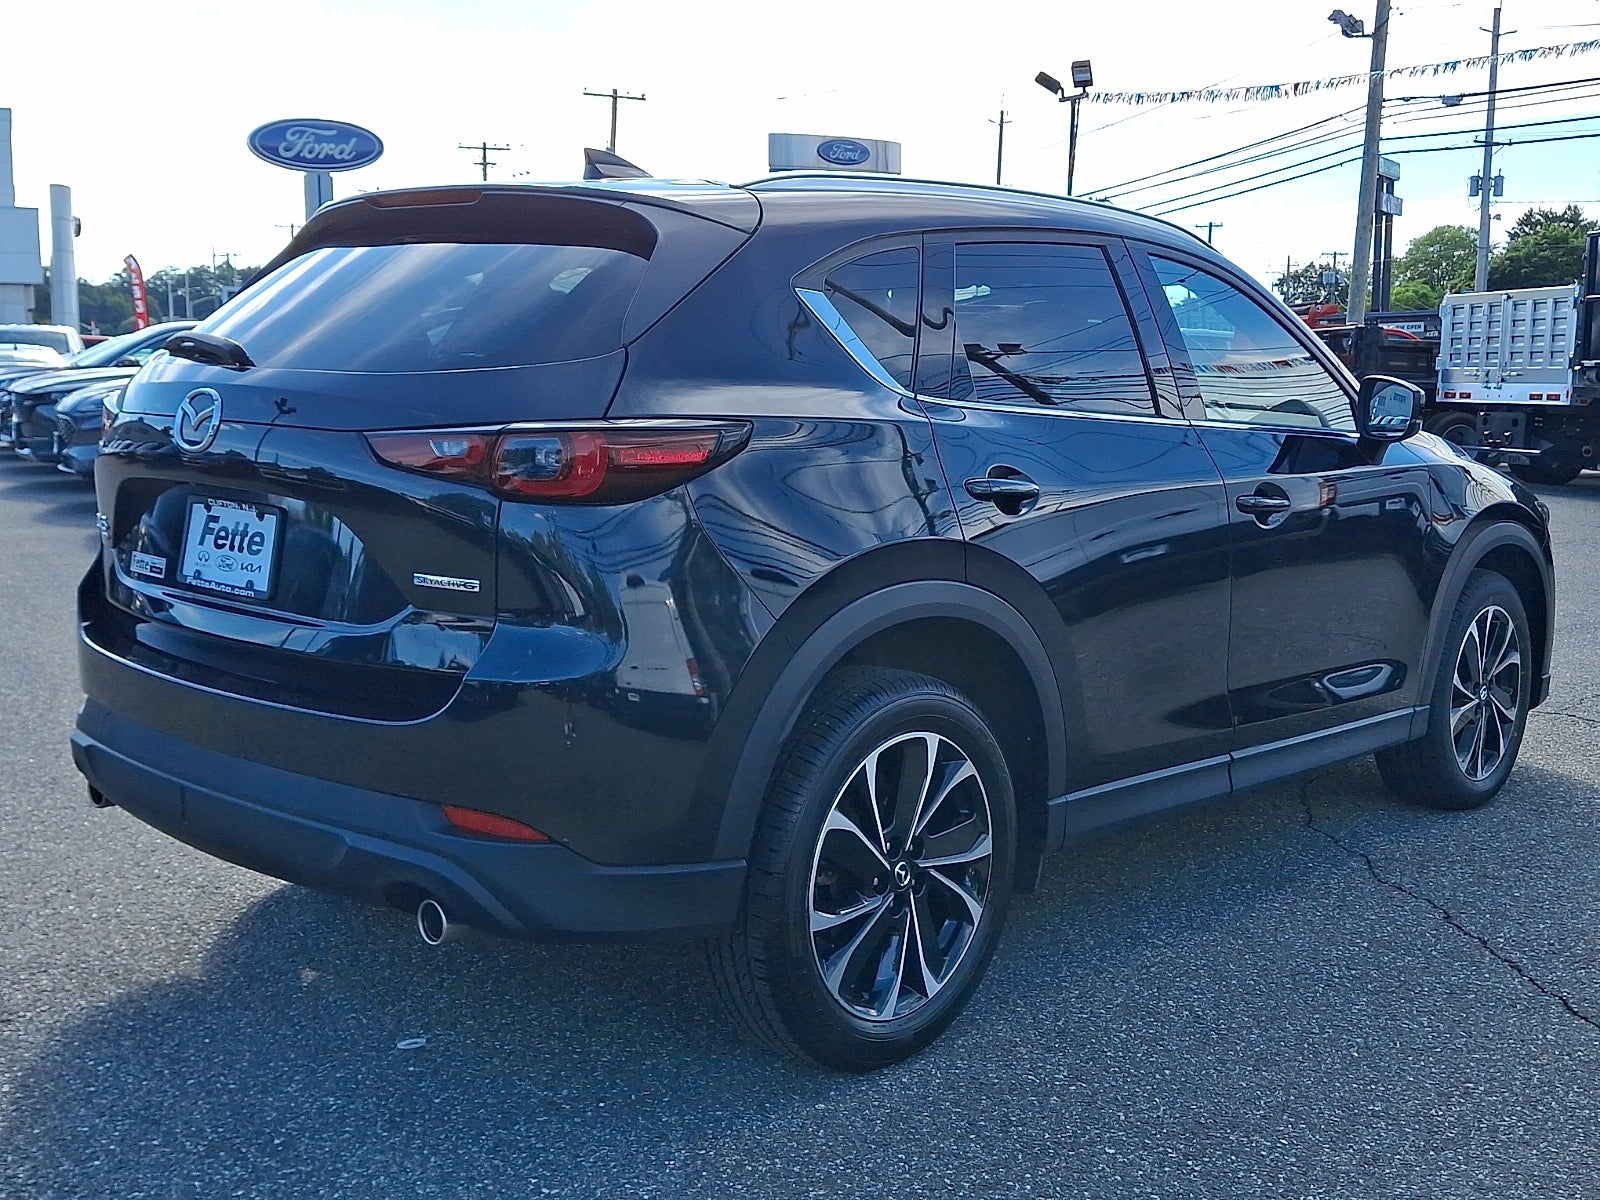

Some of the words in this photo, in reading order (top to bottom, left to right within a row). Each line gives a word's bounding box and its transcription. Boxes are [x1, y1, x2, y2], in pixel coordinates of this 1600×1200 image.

[278, 126, 357, 159] Ford
[829, 143, 861, 160] Ford
[197, 514, 265, 556] Fette
[186, 576, 255, 598] FetteAuto.com
